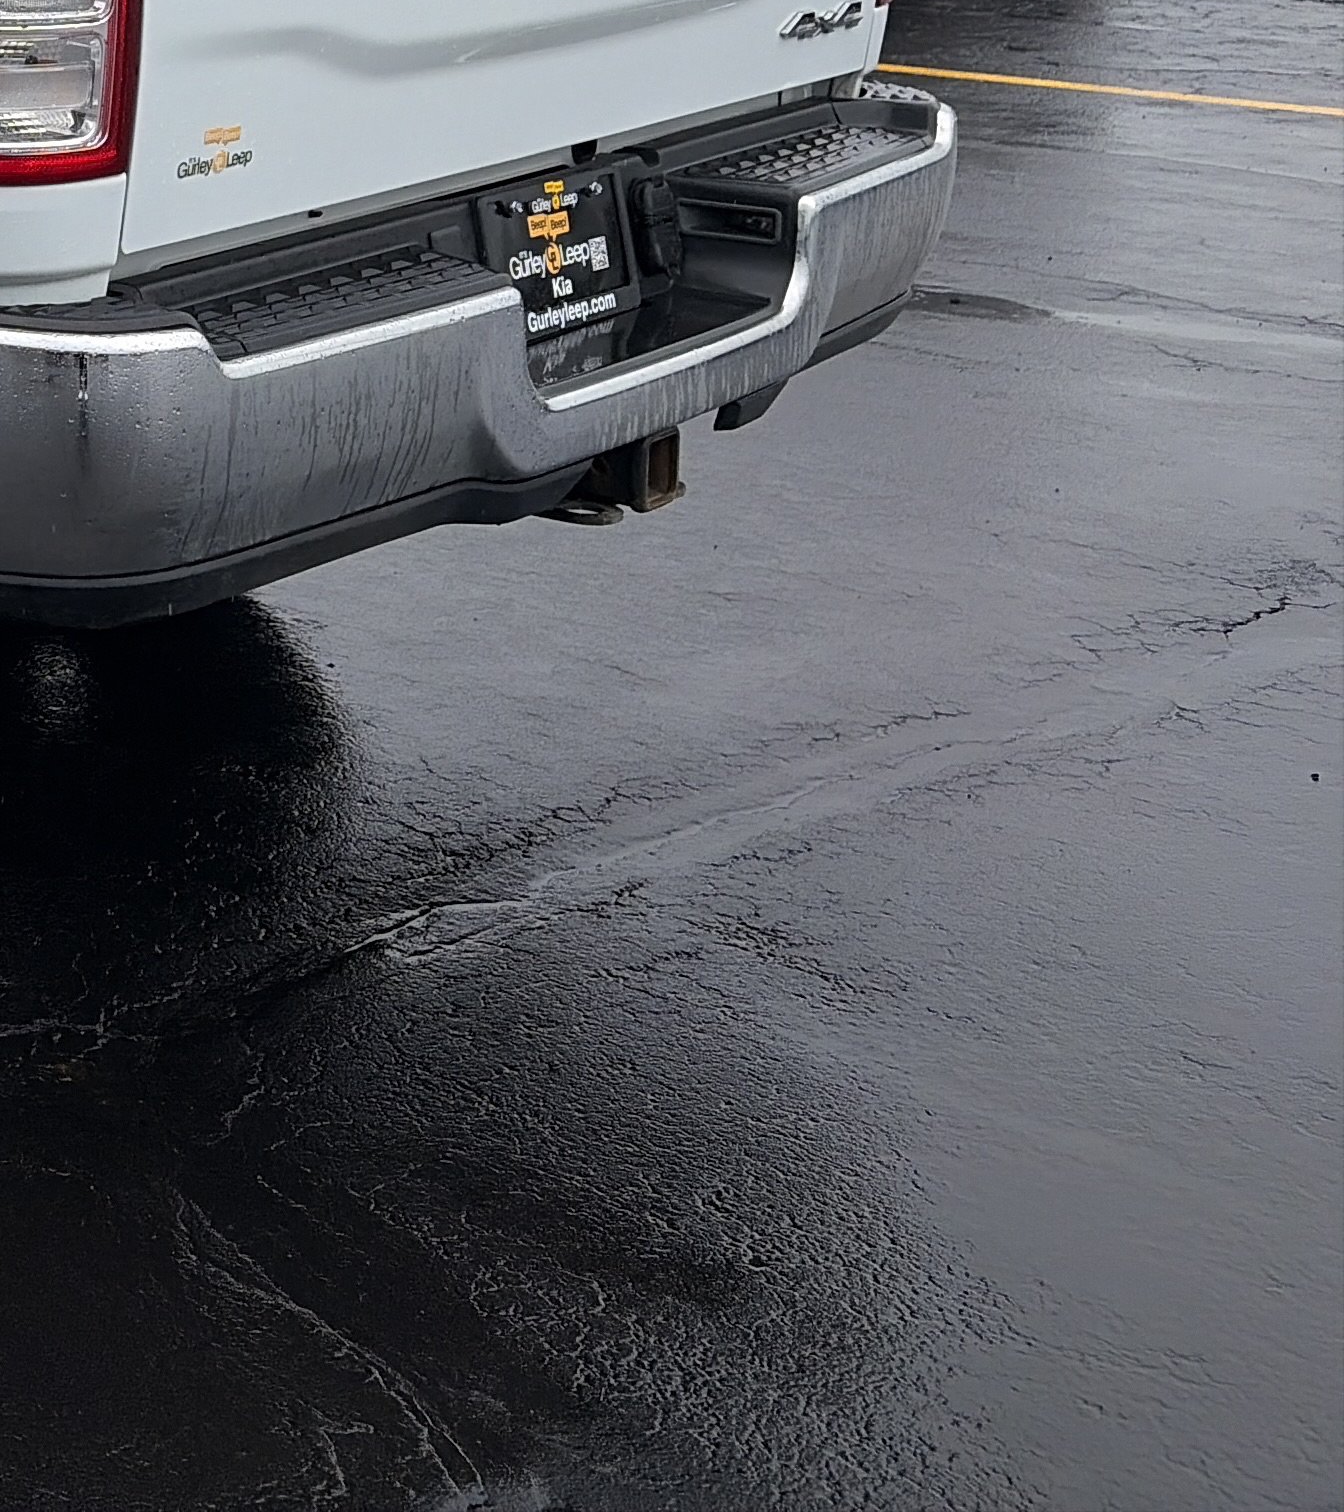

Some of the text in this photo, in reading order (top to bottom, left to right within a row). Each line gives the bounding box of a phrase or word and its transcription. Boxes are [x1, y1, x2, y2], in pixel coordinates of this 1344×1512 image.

[176, 150, 253, 179] Gurley Leep
[559, 192, 579, 208] Leep
[509, 251, 547, 280] Gurley
[558, 242, 591, 267] Leep
[551, 275, 574, 299] Kia
[527, 292, 617, 333] Gurleyleep.com
